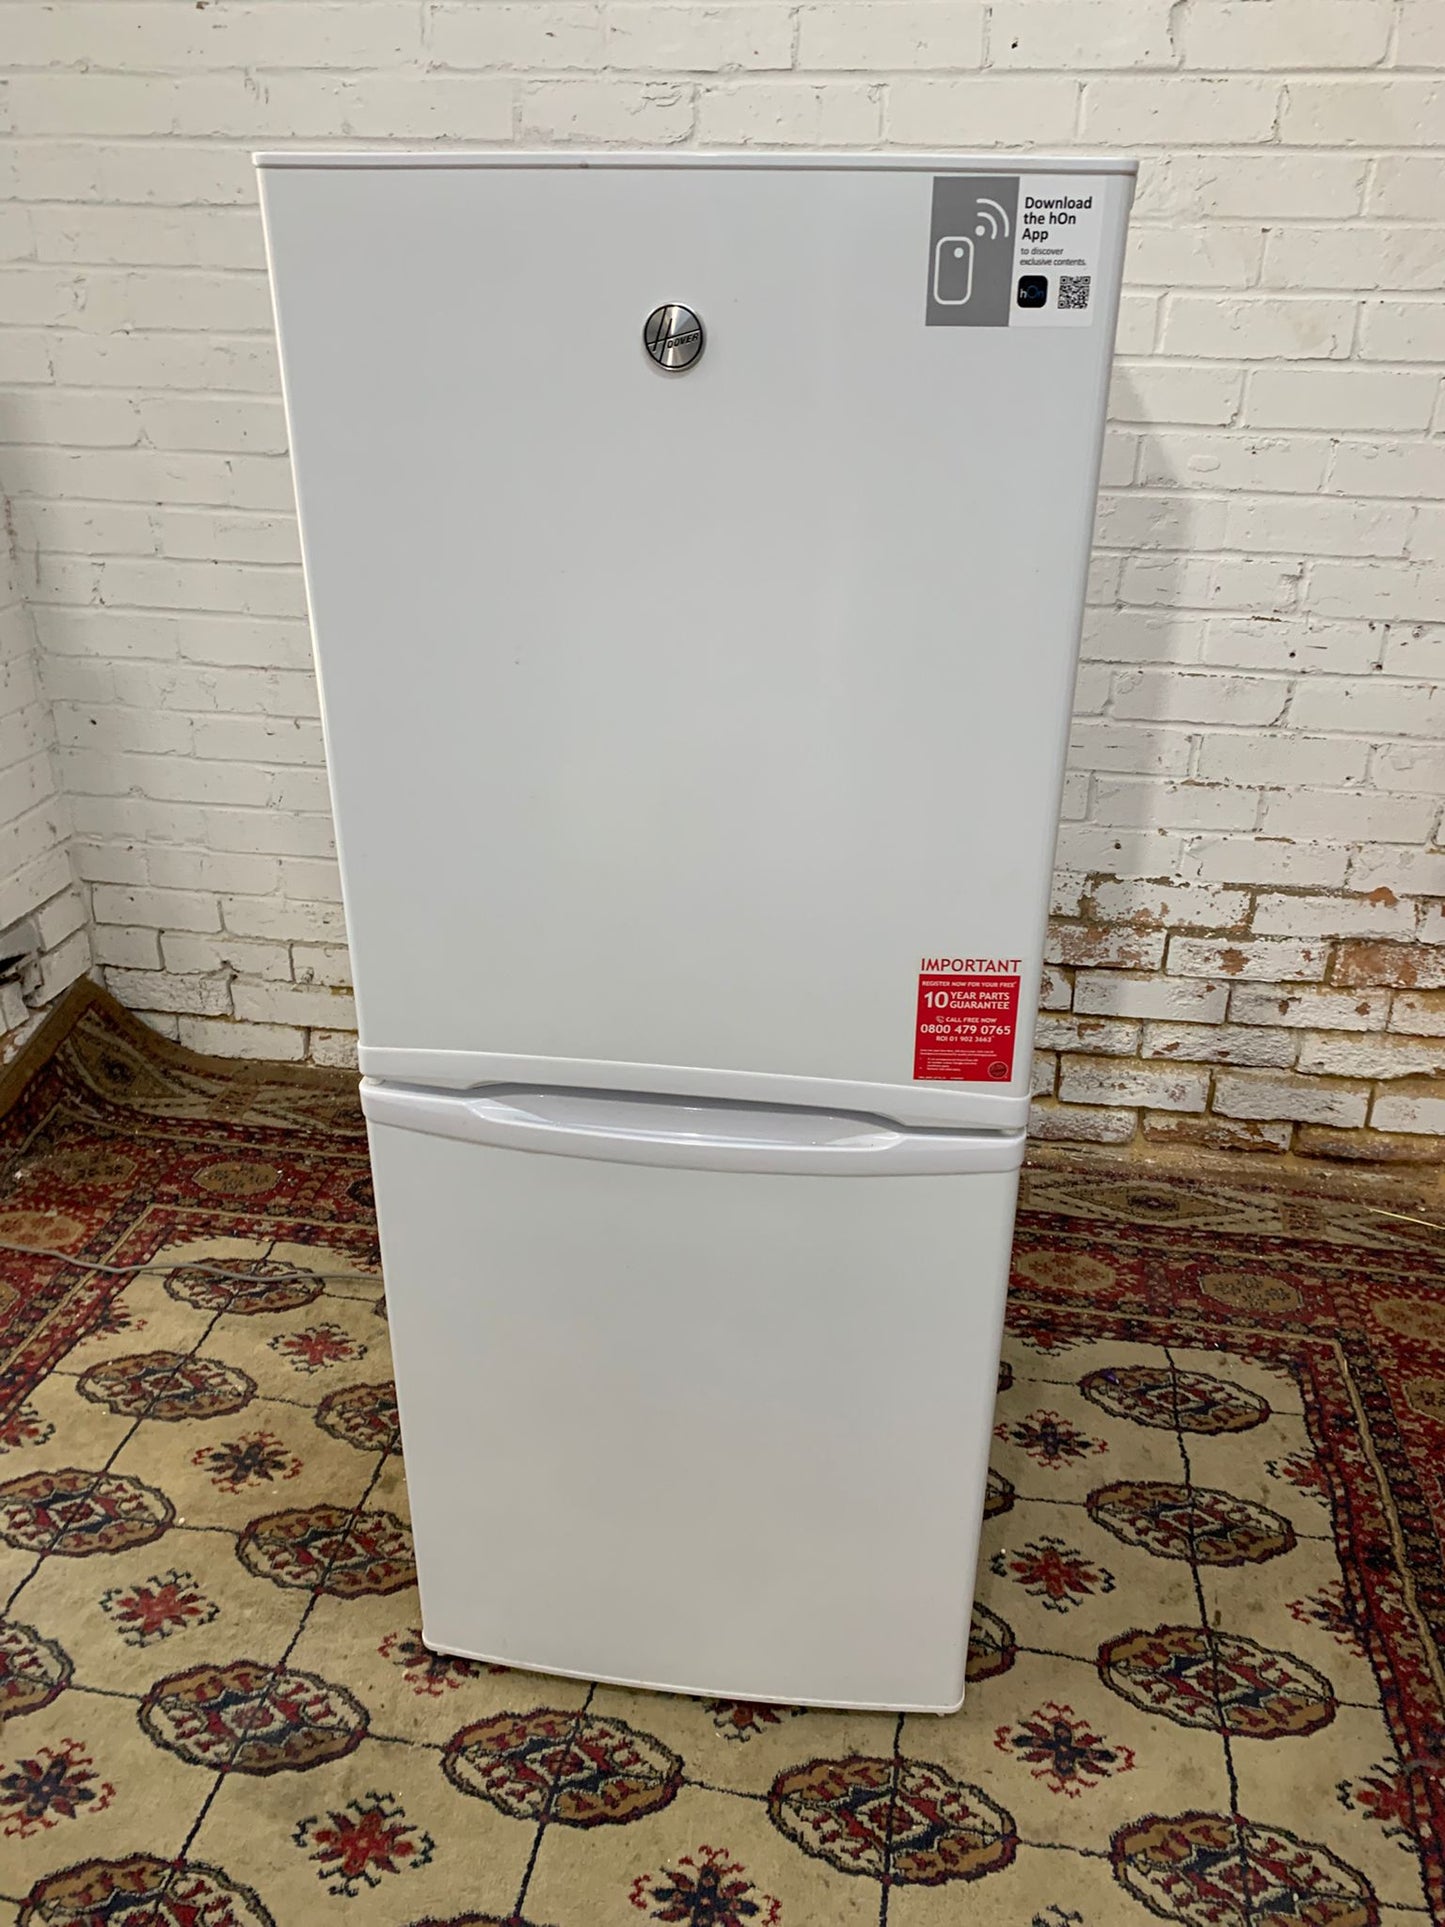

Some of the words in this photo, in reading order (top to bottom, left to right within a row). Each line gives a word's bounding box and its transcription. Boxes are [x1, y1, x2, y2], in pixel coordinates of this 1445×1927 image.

[1024, 196, 1093, 210] Download
[1023, 212, 1046, 225] the
[1049, 212, 1077, 225] hOn
[1021, 227, 1049, 243] App
[1020, 247, 1030, 256] to
[1030, 247, 1064, 256] discover
[1019, 258, 1053, 267] exclusive
[646, 306, 700, 362] HOOVER
[921, 958, 1022, 973] IMPORTANT
[924, 991, 949, 1009] 10
[950, 991, 977, 1000] YEAR
[979, 992, 1010, 1001] PARTS
[949, 1001, 1010, 1010] GUARANTEE
[920, 1024, 951, 1034] 0800
[954, 1025, 978, 1035] 479
[980, 1025, 1011, 1036] 0765
